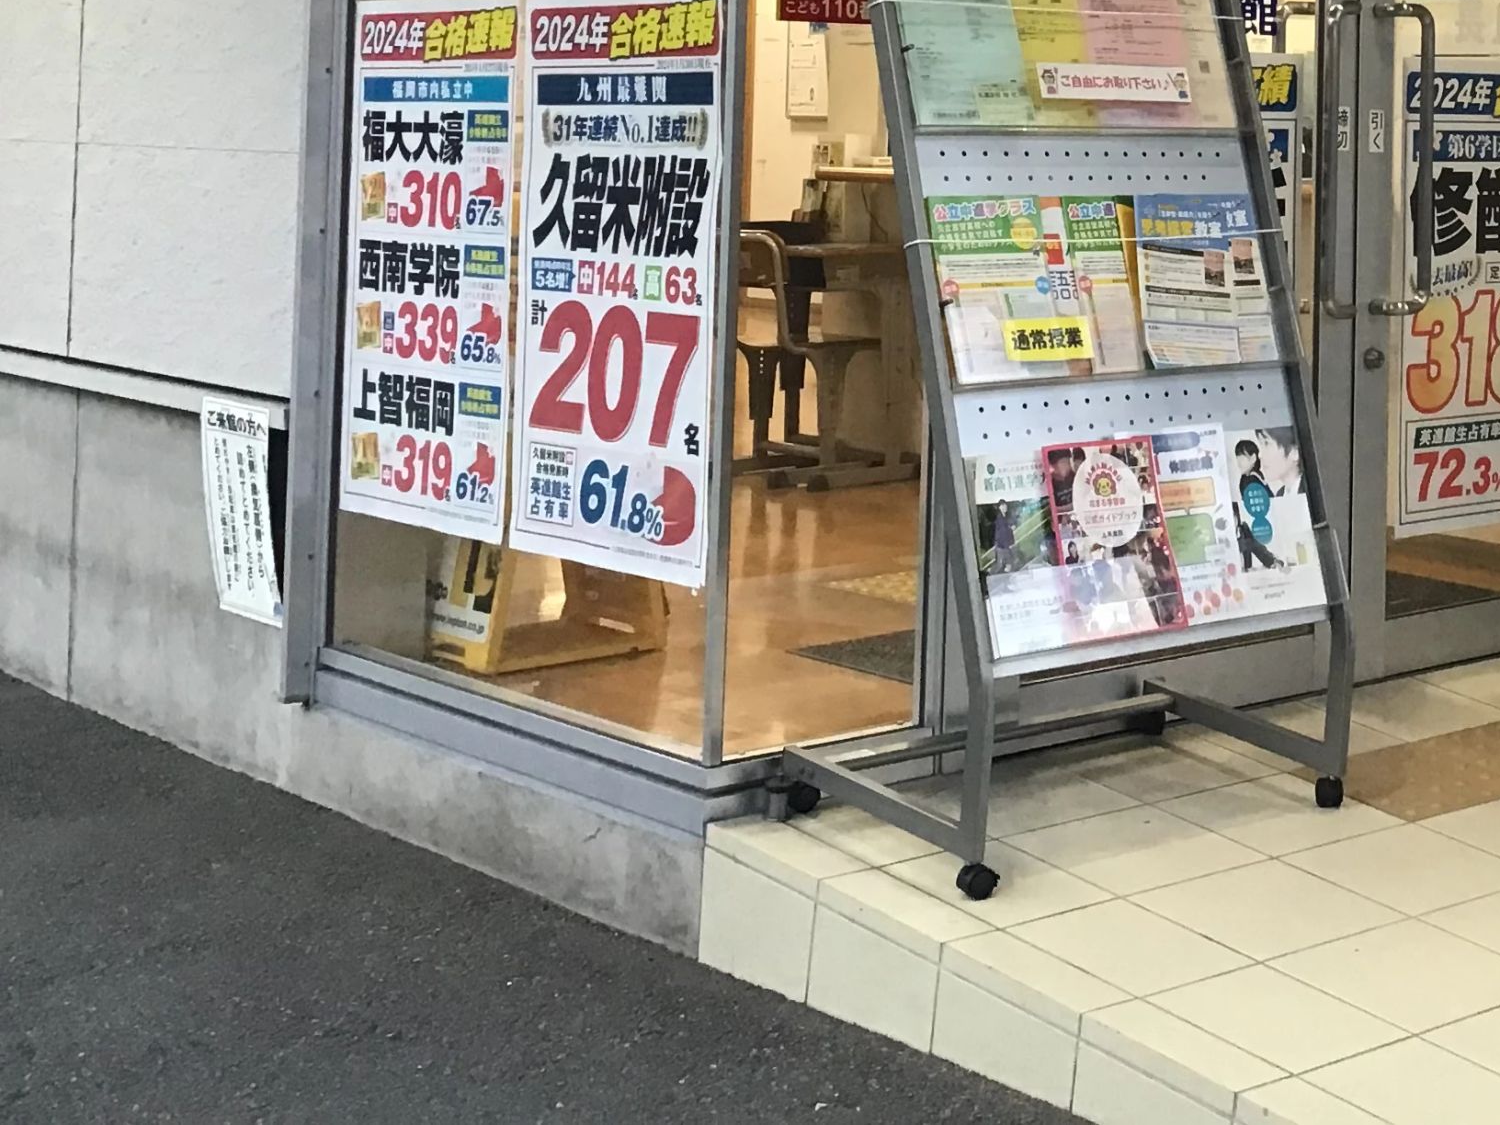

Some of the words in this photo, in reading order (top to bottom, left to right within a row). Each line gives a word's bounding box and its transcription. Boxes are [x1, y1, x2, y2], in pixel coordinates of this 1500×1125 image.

[577, 76, 668, 103] 九州最難関
[362, 109, 465, 165] 福大大濠
[1370, 111, 1383, 150] 引く
[532, 153, 711, 258] 久留米附設
[359, 239, 461, 299] 西南学院
[532, 299, 547, 325] 計
[1011, 327, 1084, 351] 通常授業
[353, 368, 455, 436] 上智福岡
[206, 410, 266, 437] ご来館の方へ
[531, 498, 569, 521] 占有率
[579, 459, 662, 536] 61.8%
